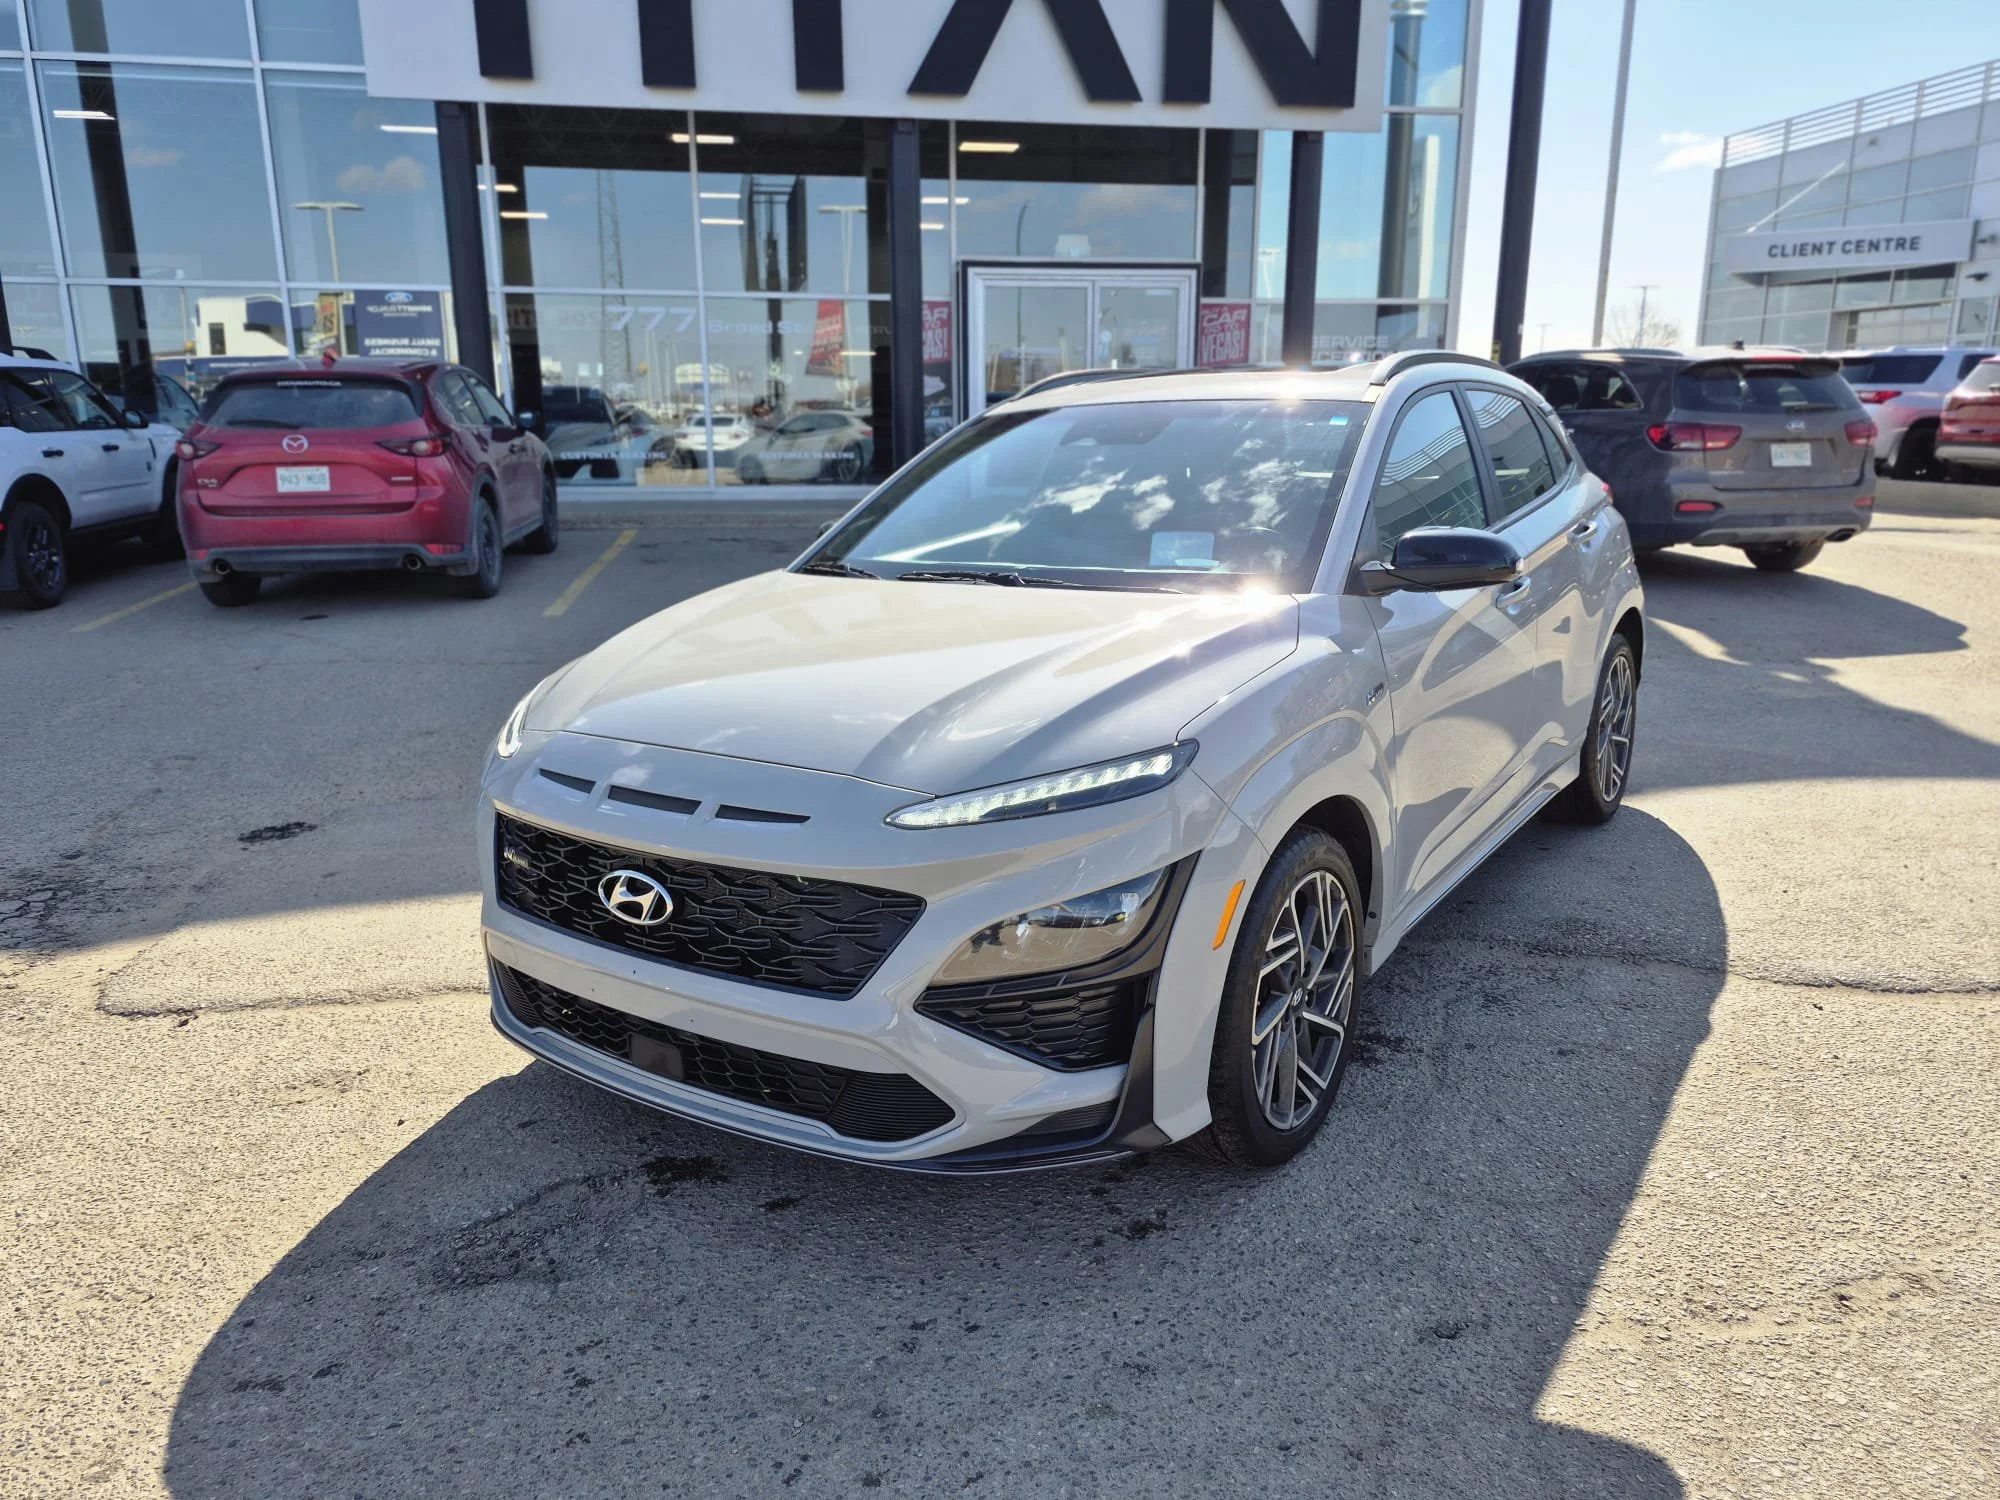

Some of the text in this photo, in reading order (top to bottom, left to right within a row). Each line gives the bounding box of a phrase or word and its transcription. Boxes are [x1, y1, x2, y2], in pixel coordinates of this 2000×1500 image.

[1768, 236, 1922, 258] CLIENT CENTRE
[606, 305, 697, 332] 777
[922, 307, 949, 322] AR
[1203, 310, 1248, 329] CAR
[922, 328, 948, 361] AS!
[1202, 331, 1244, 363] VEGAS!
